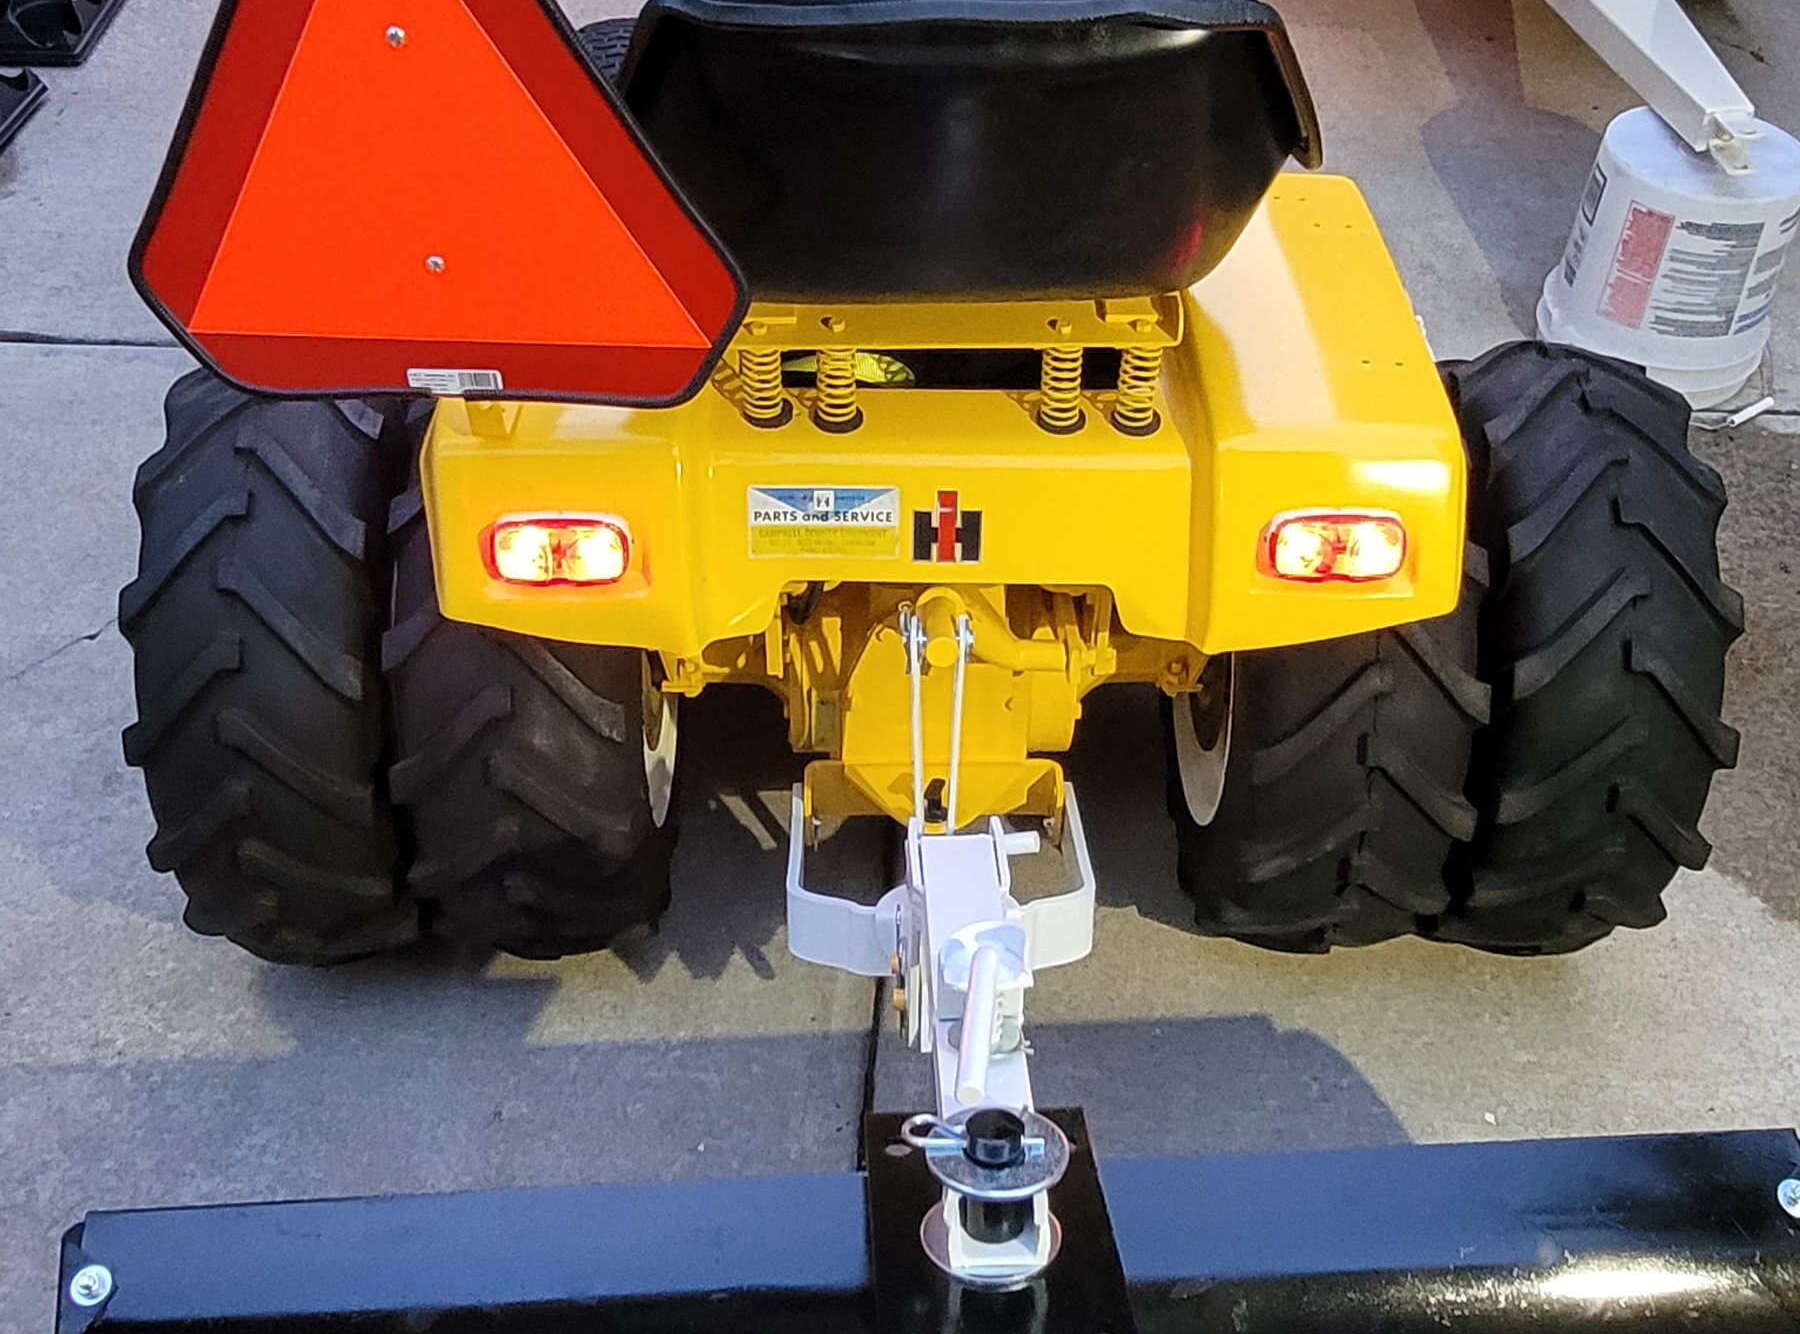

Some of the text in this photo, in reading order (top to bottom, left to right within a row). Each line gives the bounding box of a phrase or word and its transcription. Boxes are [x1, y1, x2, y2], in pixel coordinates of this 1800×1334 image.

[754, 511, 892, 522] PARTS and SERVICE
